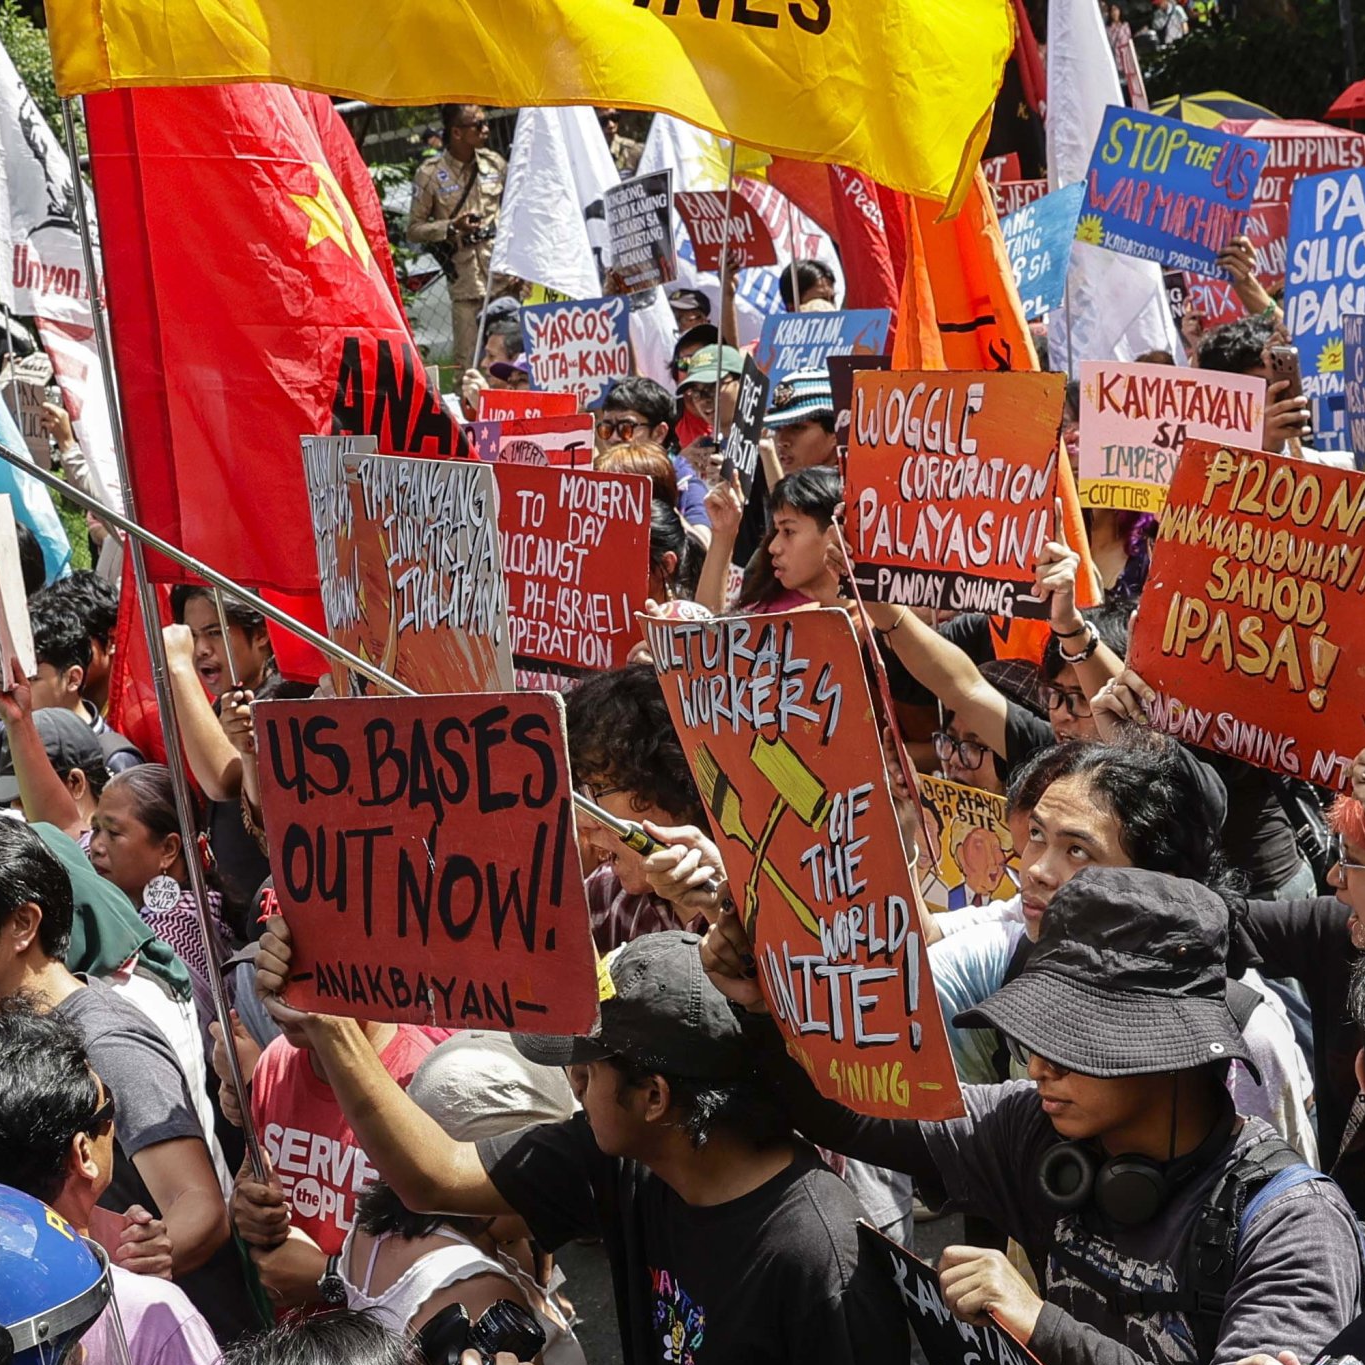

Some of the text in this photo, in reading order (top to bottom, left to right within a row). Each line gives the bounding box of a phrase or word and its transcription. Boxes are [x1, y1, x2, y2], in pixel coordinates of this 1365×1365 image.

[1102, 117, 1258, 201] STOP THE US
[681, 191, 728, 220] BAN
[1089, 169, 1150, 224] WAR
[689, 211, 756, 246] TRUMP!
[11, 243, 81, 297] Unyon
[534, 310, 612, 351] MARCOS
[529, 343, 628, 383] TUTA KANO
[855, 381, 986, 457] WOGGLE
[1095, 370, 1255, 433] KAMATAYAN
[1152, 422, 1188, 453] SA
[357, 457, 488, 529] PAMBANSANG
[515, 473, 646, 528] TO MODERN
[899, 450, 1058, 503] CORPORATION
[567, 510, 608, 547] DAY
[1159, 502, 1365, 592] NAKAKABUBUHAY
[522, 585, 632, 635] PH-ISRAELI
[1160, 591, 1341, 711] IPASA!
[677, 664, 844, 745] WORKERS
[357, 705, 559, 825] BASES
[1211, 710, 1301, 774] SINING
[828, 781, 875, 843] OF
[281, 797, 571, 953] OUT NOW!
[800, 835, 872, 904] THE
[819, 895, 910, 961] WORLD
[760, 931, 923, 1051] UNITE!
[264, 1122, 381, 1194] SERVE
[295, 1187, 320, 1207] the
